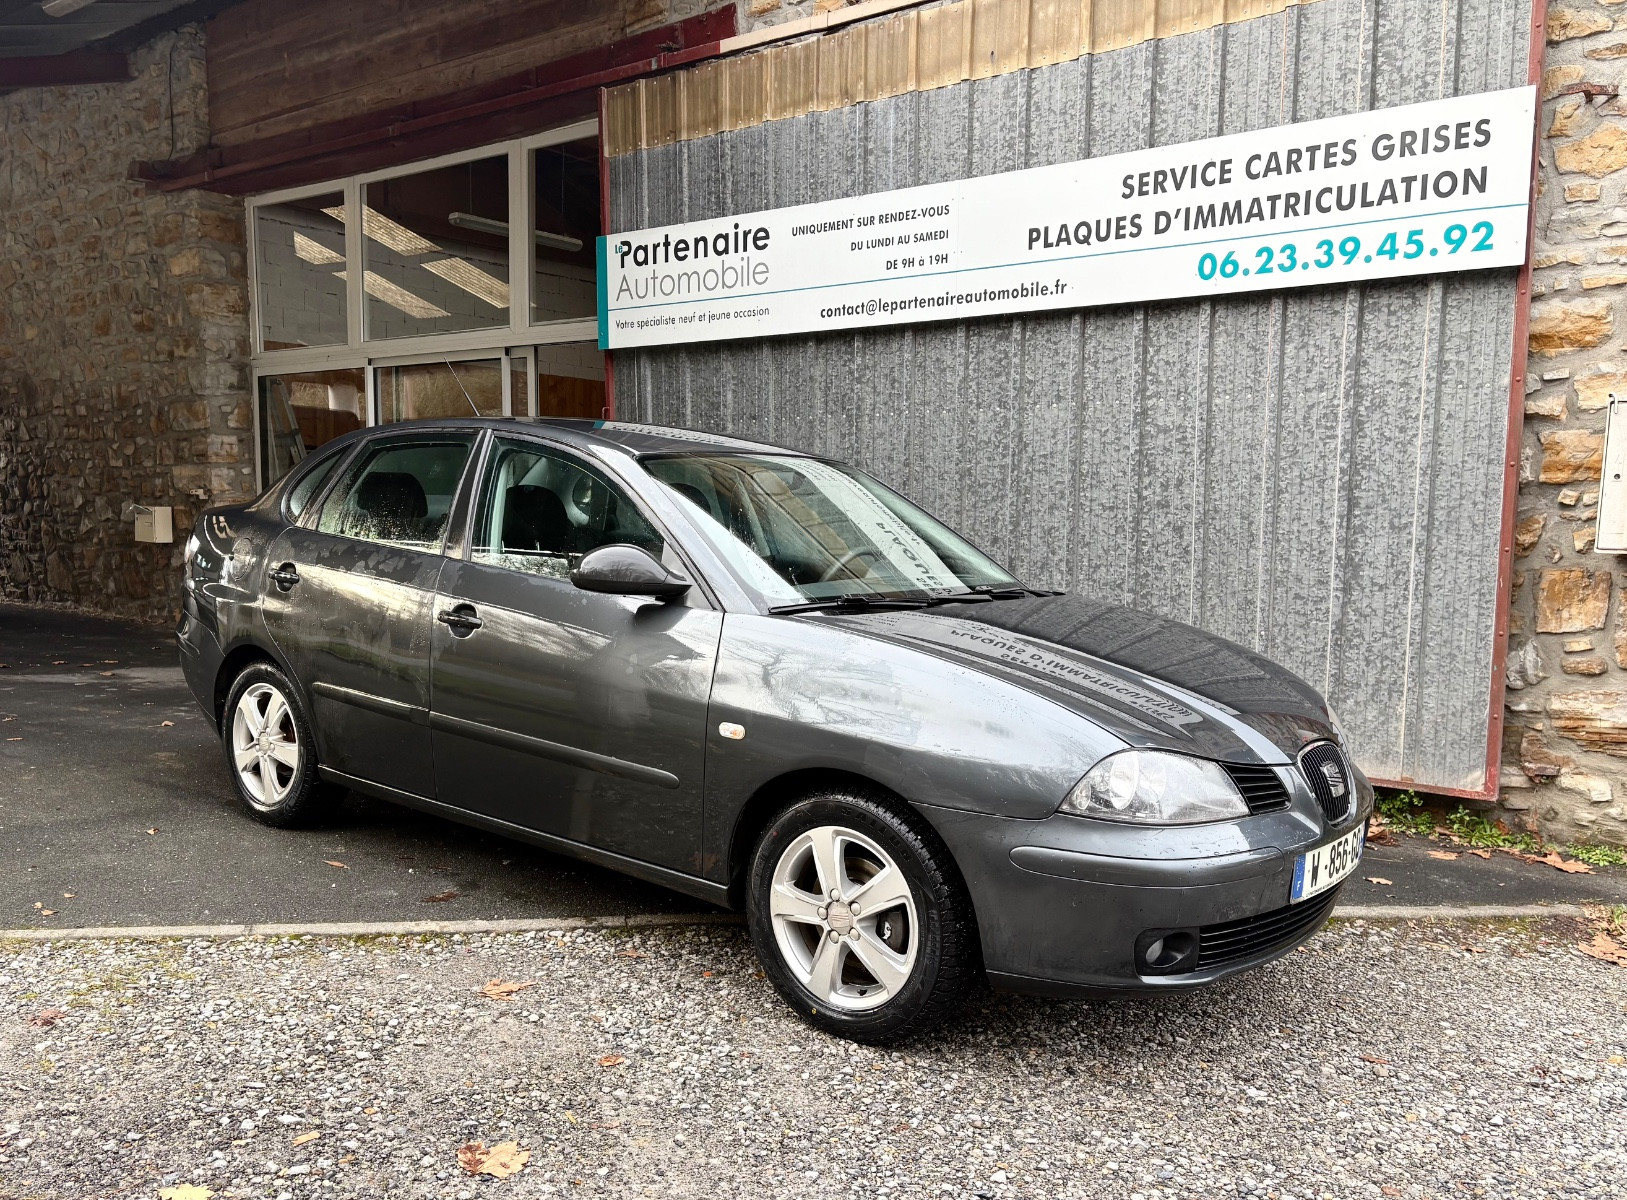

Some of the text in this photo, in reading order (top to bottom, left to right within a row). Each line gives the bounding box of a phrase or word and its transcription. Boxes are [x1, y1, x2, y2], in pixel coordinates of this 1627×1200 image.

[1121, 118, 1491, 200] SERVICE CARTES GRISES
[791, 204, 950, 237] UNIQUEMENT SUR RENDEZ-VOUS
[1028, 166, 1488, 250] PLAQUES D'IMMATRICULATION
[620, 222, 770, 268] Partenaire
[850, 229, 949, 252] DU LUNDI AU SAMEDI
[1198, 221, 1494, 281] 06.23.39.45.92
[616, 256, 769, 301] Automobile
[885, 253, 949, 271] DE 9H à 19H
[615, 307, 770, 330] Votre spécialiste neuf et jeune occasion
[820, 279, 1067, 318] contact@lepartenaireautomobile.fr
